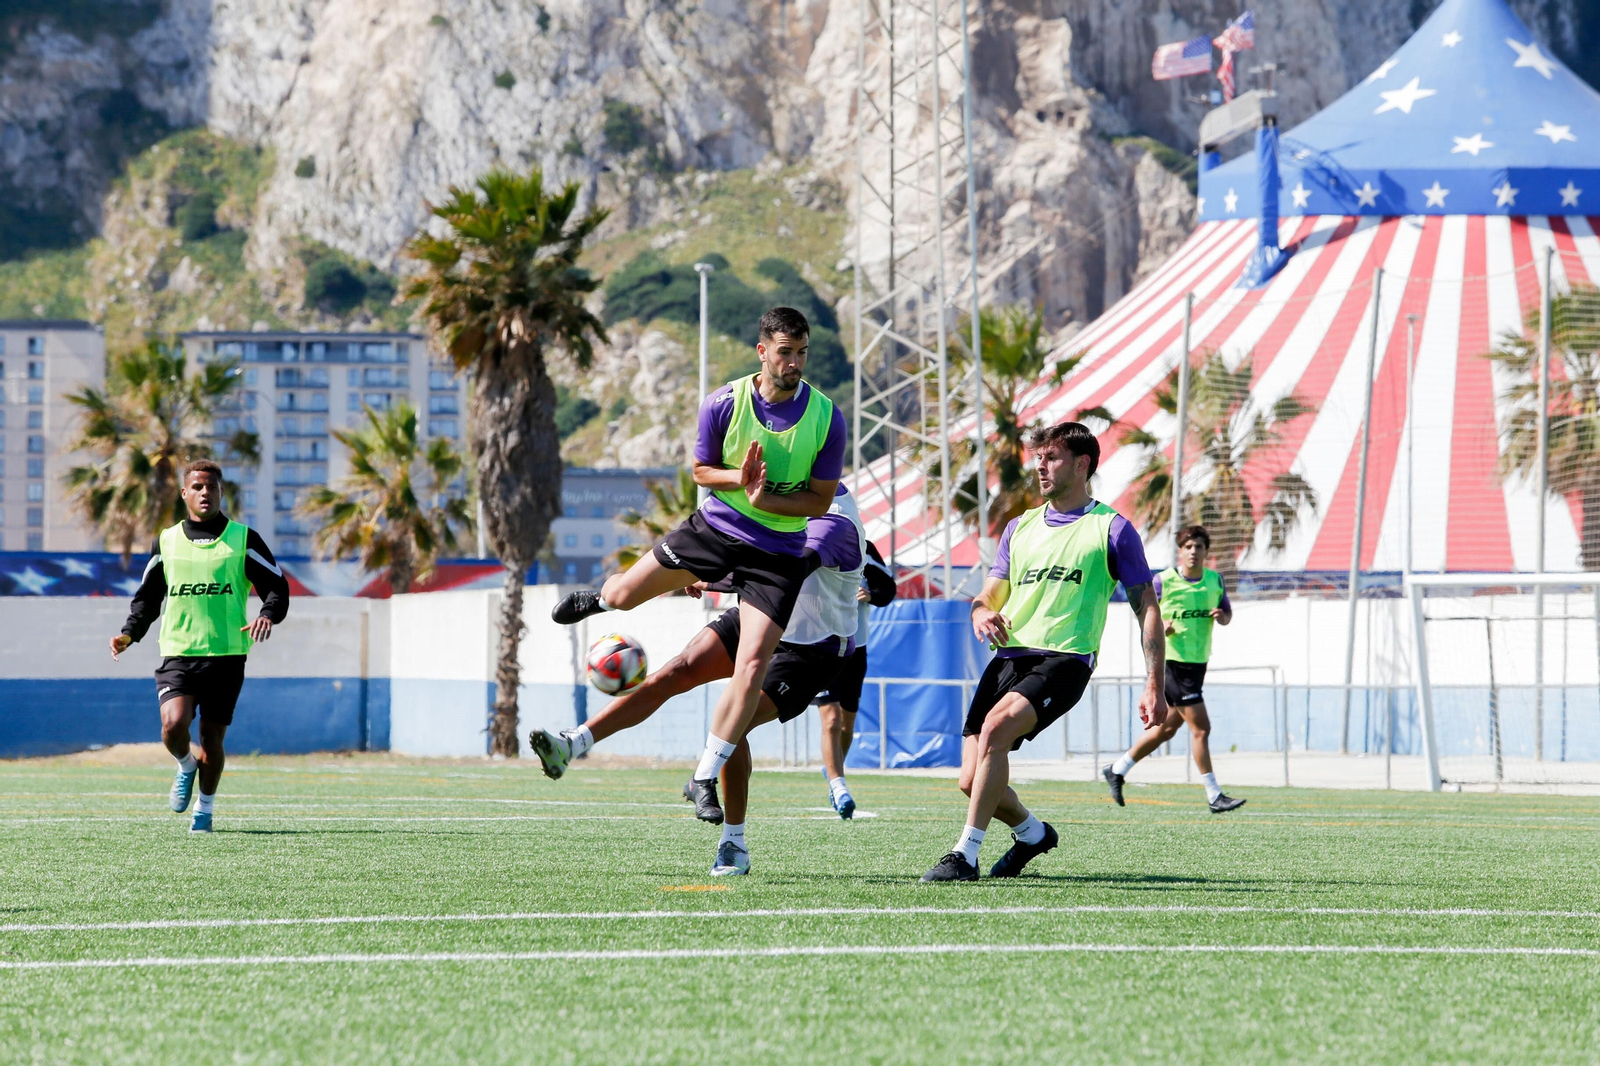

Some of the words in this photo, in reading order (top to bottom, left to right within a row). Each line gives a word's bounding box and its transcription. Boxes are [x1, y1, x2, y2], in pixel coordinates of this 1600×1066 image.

[169, 582, 234, 597] LEGEA
[1172, 608, 1213, 620] LEGE
[777, 681, 790, 695] 17
